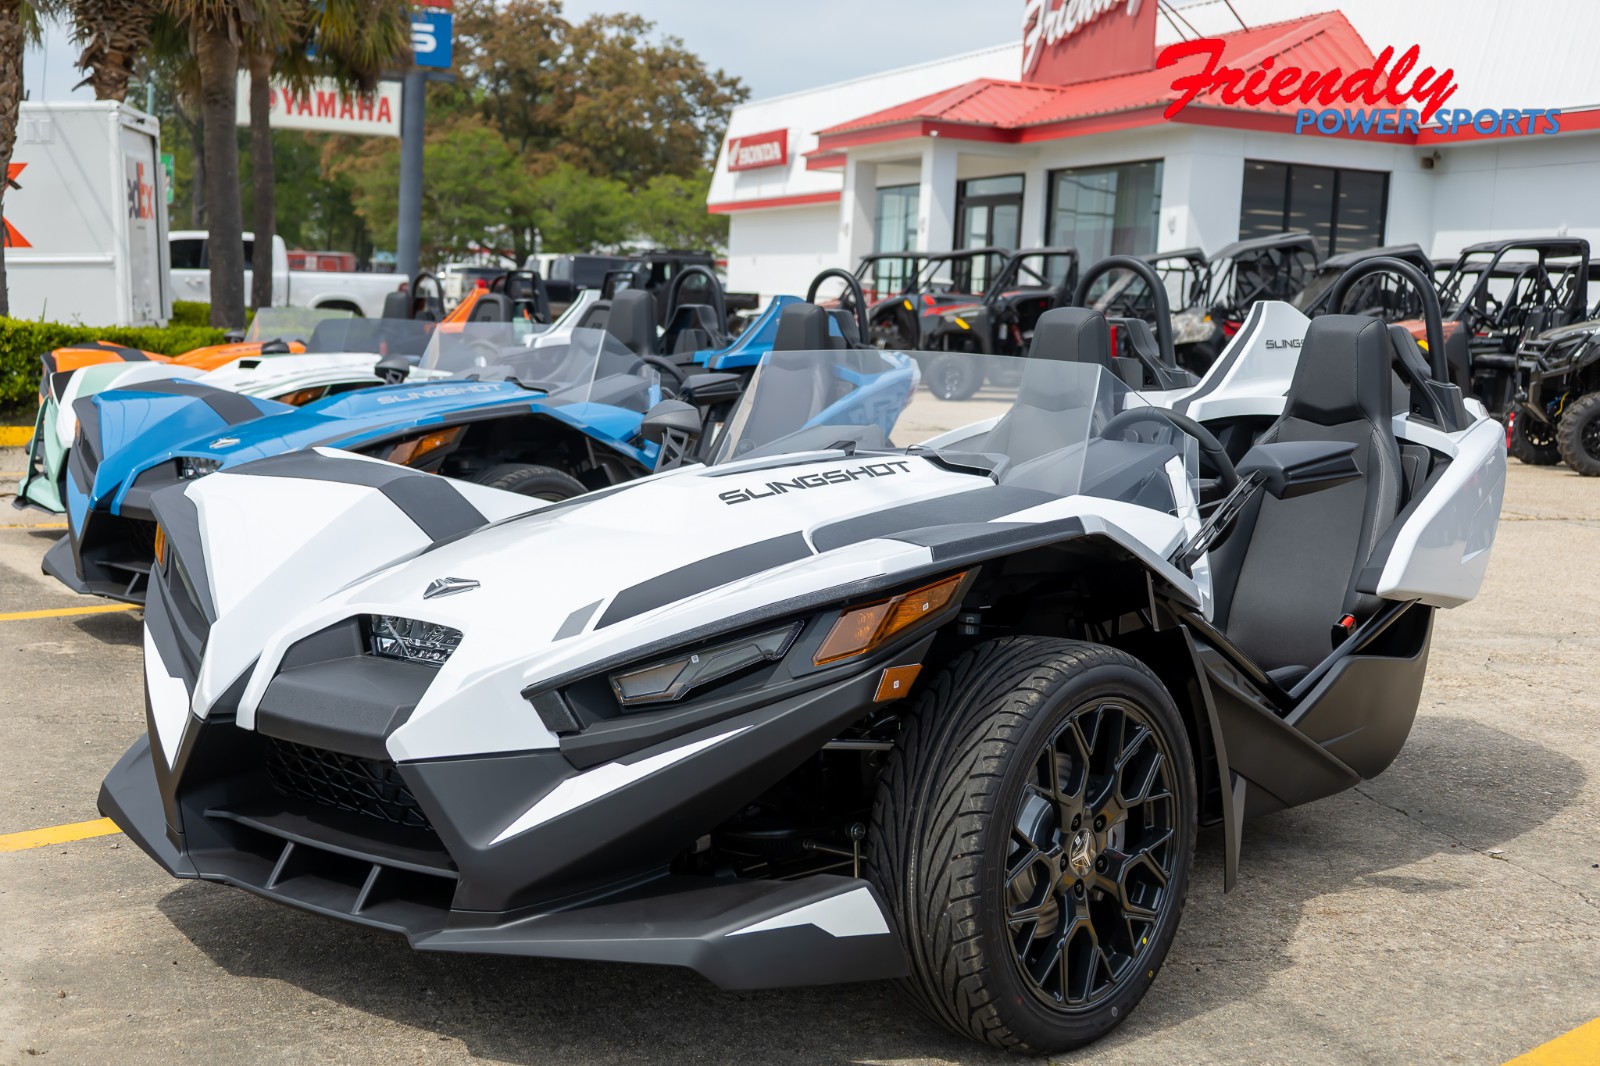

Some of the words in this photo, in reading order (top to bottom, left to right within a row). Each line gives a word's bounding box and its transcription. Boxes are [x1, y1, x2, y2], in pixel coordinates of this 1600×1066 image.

[281, 87, 393, 124] YAMAHA
[739, 141, 782, 166] HONDA
[377, 383, 501, 405] SLINGSHOT
[718, 460, 911, 506] SLINGSHOT
